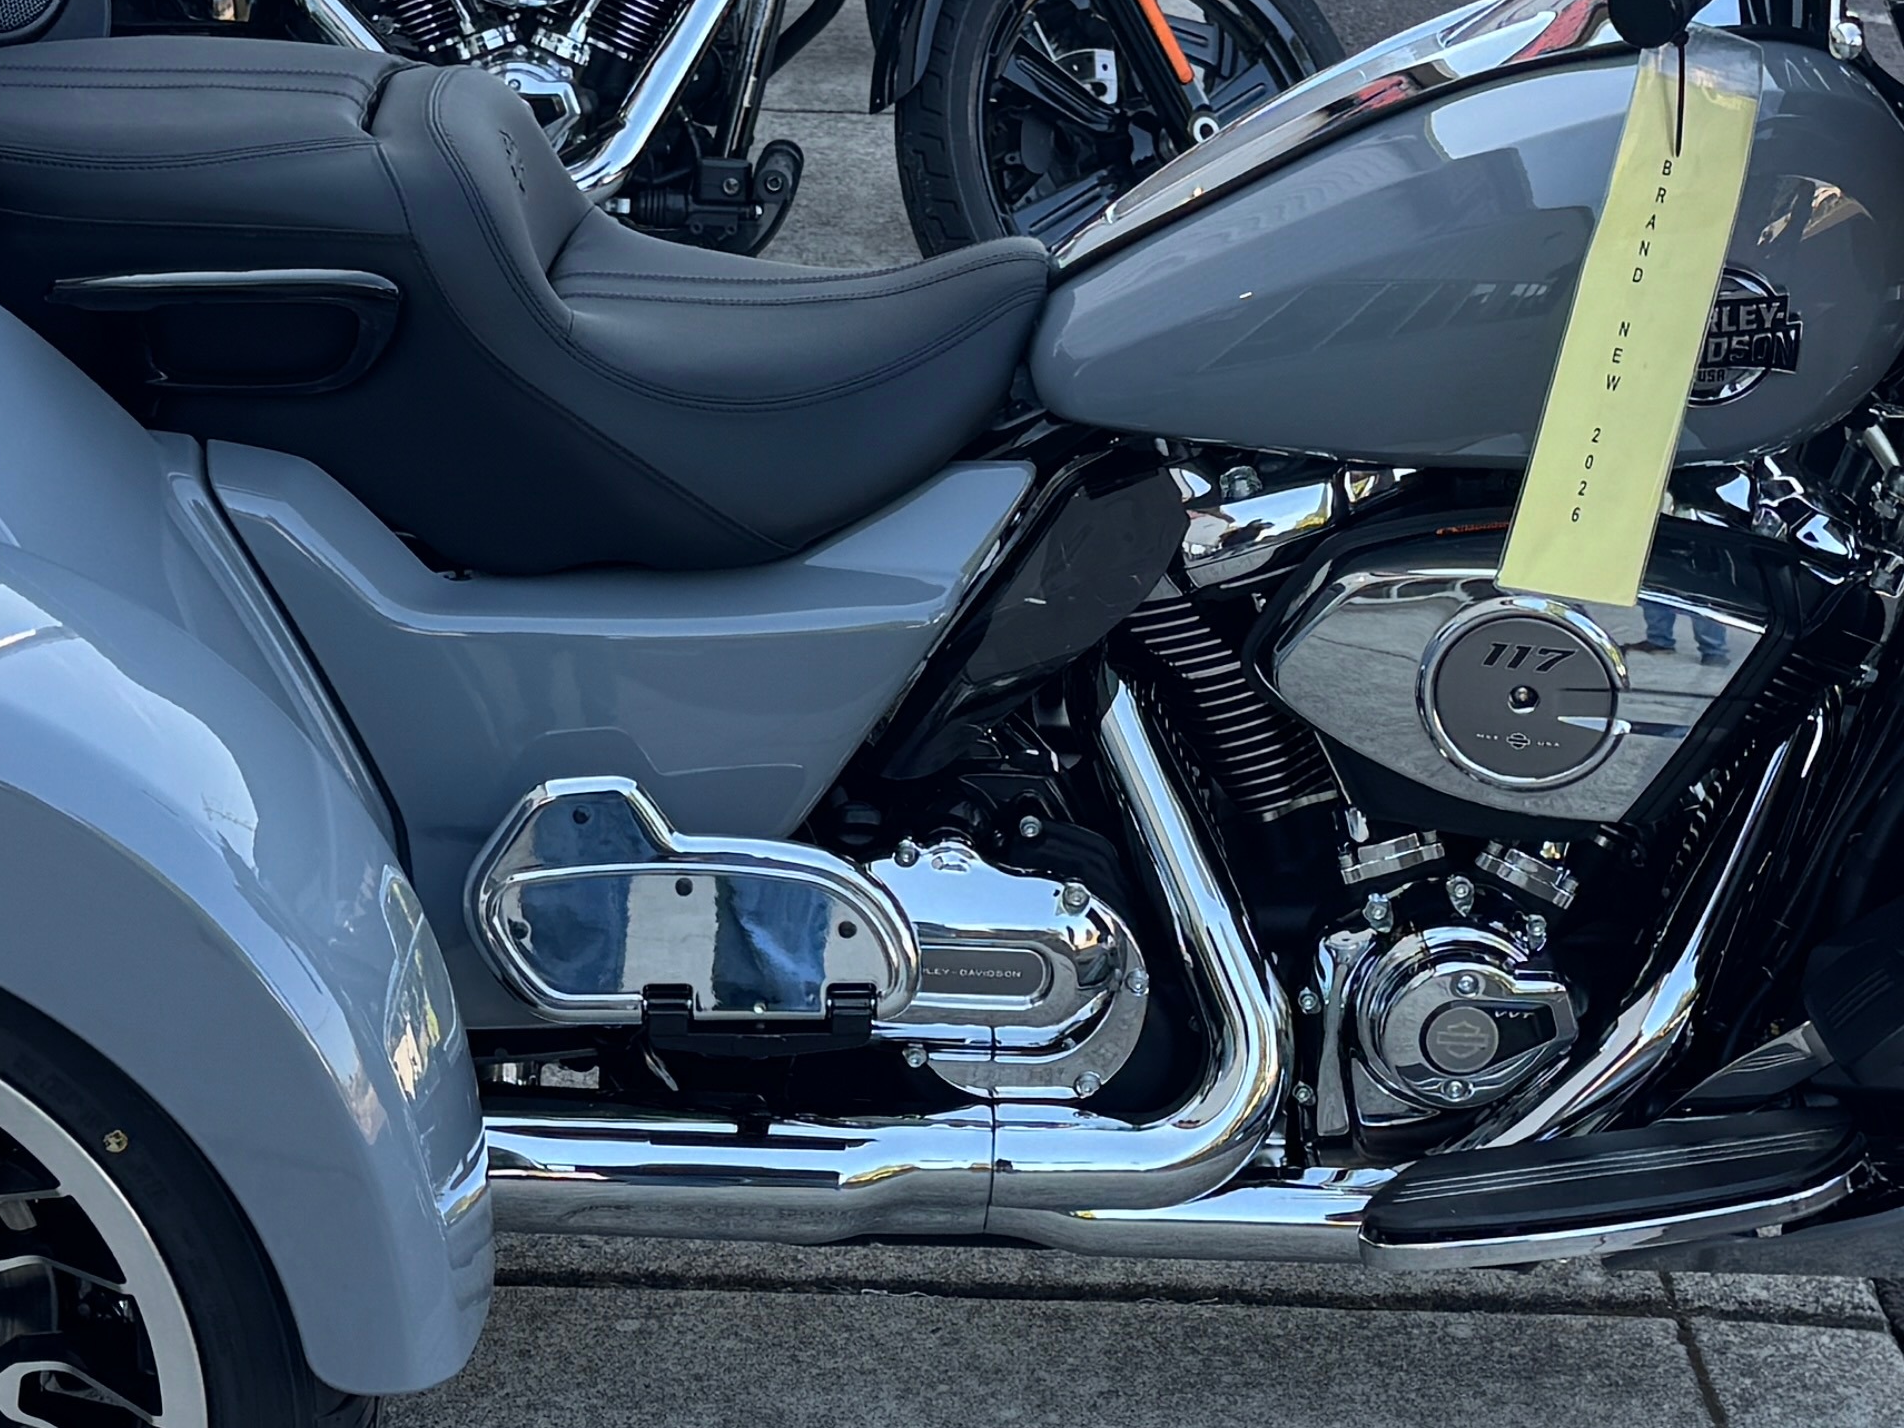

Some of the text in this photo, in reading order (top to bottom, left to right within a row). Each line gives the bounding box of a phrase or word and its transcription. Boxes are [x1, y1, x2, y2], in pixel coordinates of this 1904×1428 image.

[1571, 160, 1673, 524] BRAND NEW 2026
[1481, 642, 1579, 673] 117
